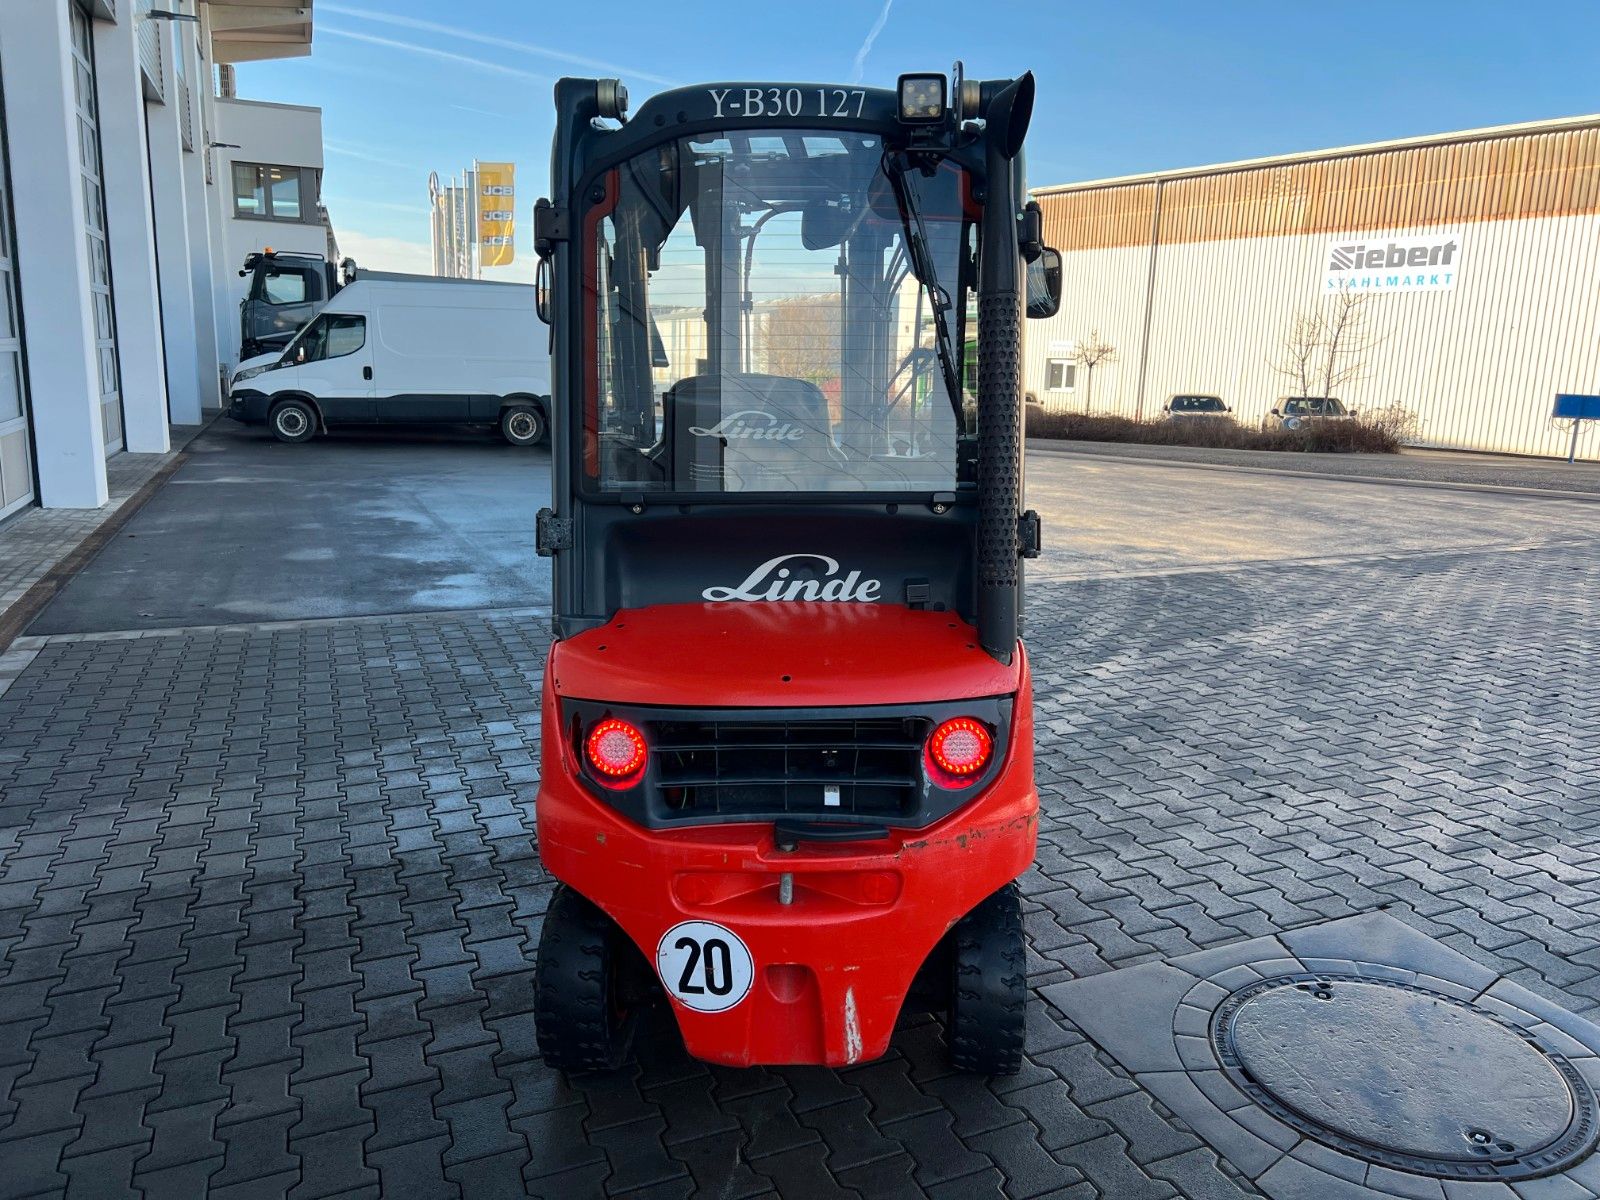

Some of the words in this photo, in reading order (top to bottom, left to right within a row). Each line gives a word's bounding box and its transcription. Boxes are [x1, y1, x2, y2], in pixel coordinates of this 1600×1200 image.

[708, 88, 803, 118] Y-B30
[816, 89, 867, 118] 127
[482, 185, 513, 196] JCB
[483, 211, 513, 221] JCB
[483, 236, 513, 246] JCB
[1329, 240, 1458, 271] Siebert
[1327, 273, 1453, 289] STAHLMARKT
[688, 410, 804, 440] Linde
[702, 553, 882, 603] Linde
[674, 937, 733, 996] 20
